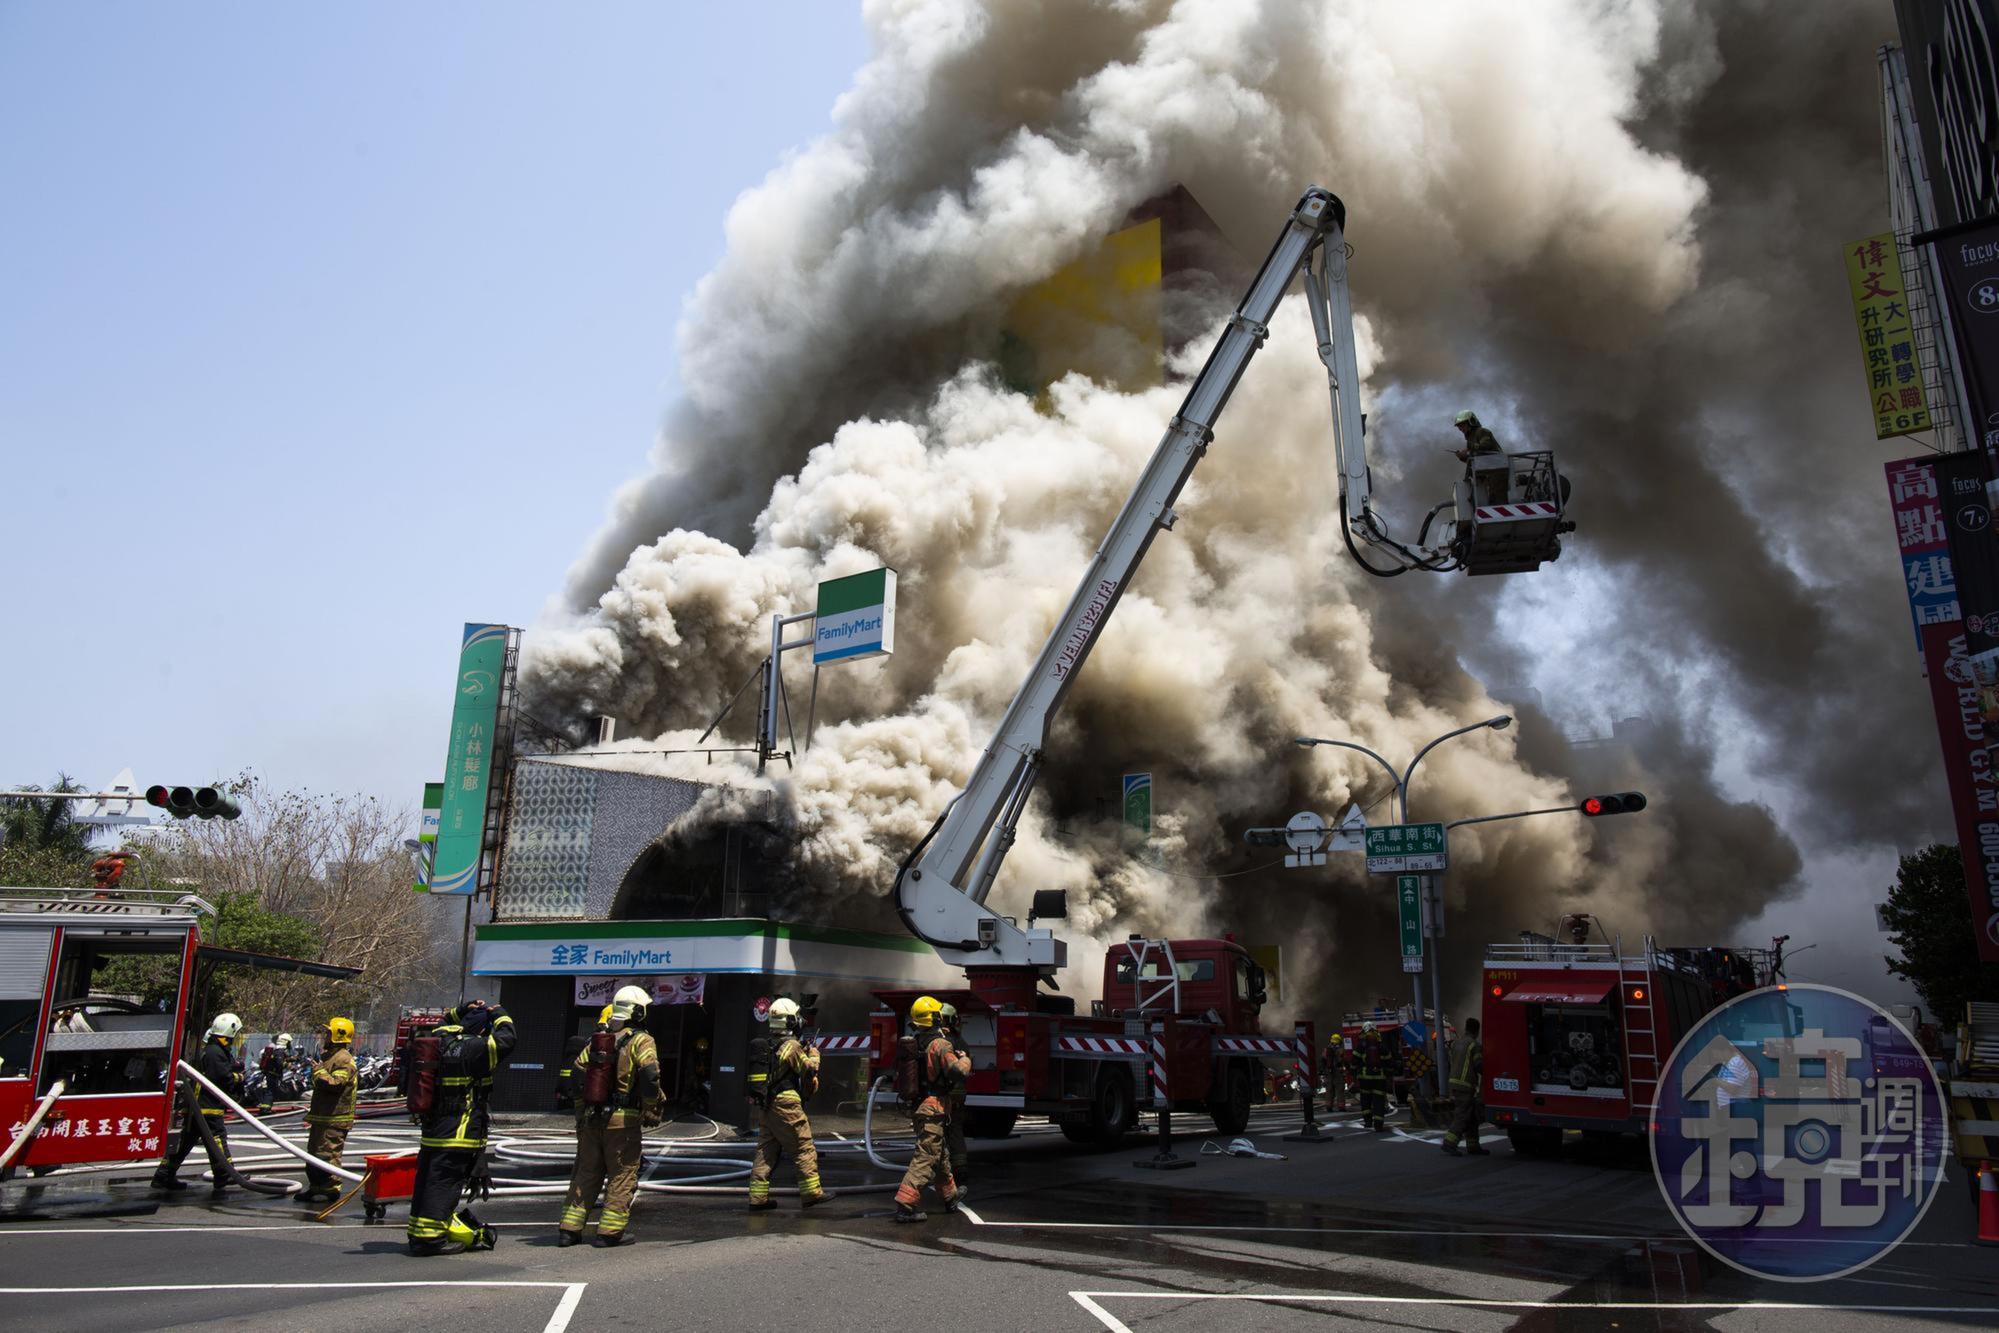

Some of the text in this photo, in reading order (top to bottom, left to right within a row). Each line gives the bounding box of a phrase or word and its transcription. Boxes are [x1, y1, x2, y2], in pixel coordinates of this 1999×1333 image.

[1861, 306, 1893, 389] 升研究所
[1883, 301, 1916, 384] 大一轉學
[1896, 411, 1926, 429] 6F
[1951, 475, 1982, 492] focus
[817, 614, 884, 643] FamilyMart
[1059, 627, 1091, 665] VEMA
[461, 722, 484, 792] 小林髮廊
[1969, 748, 1999, 813] GYM
[1371, 826, 1436, 843] 西華南街
[1375, 844, 1401, 853] Sihua
[1405, 893, 1417, 955] 中山路
[550, 944, 671, 968] 全家 FamilyMart
[578, 979, 619, 1000] Sweet
[127, 1136, 160, 1153] 敬贈
